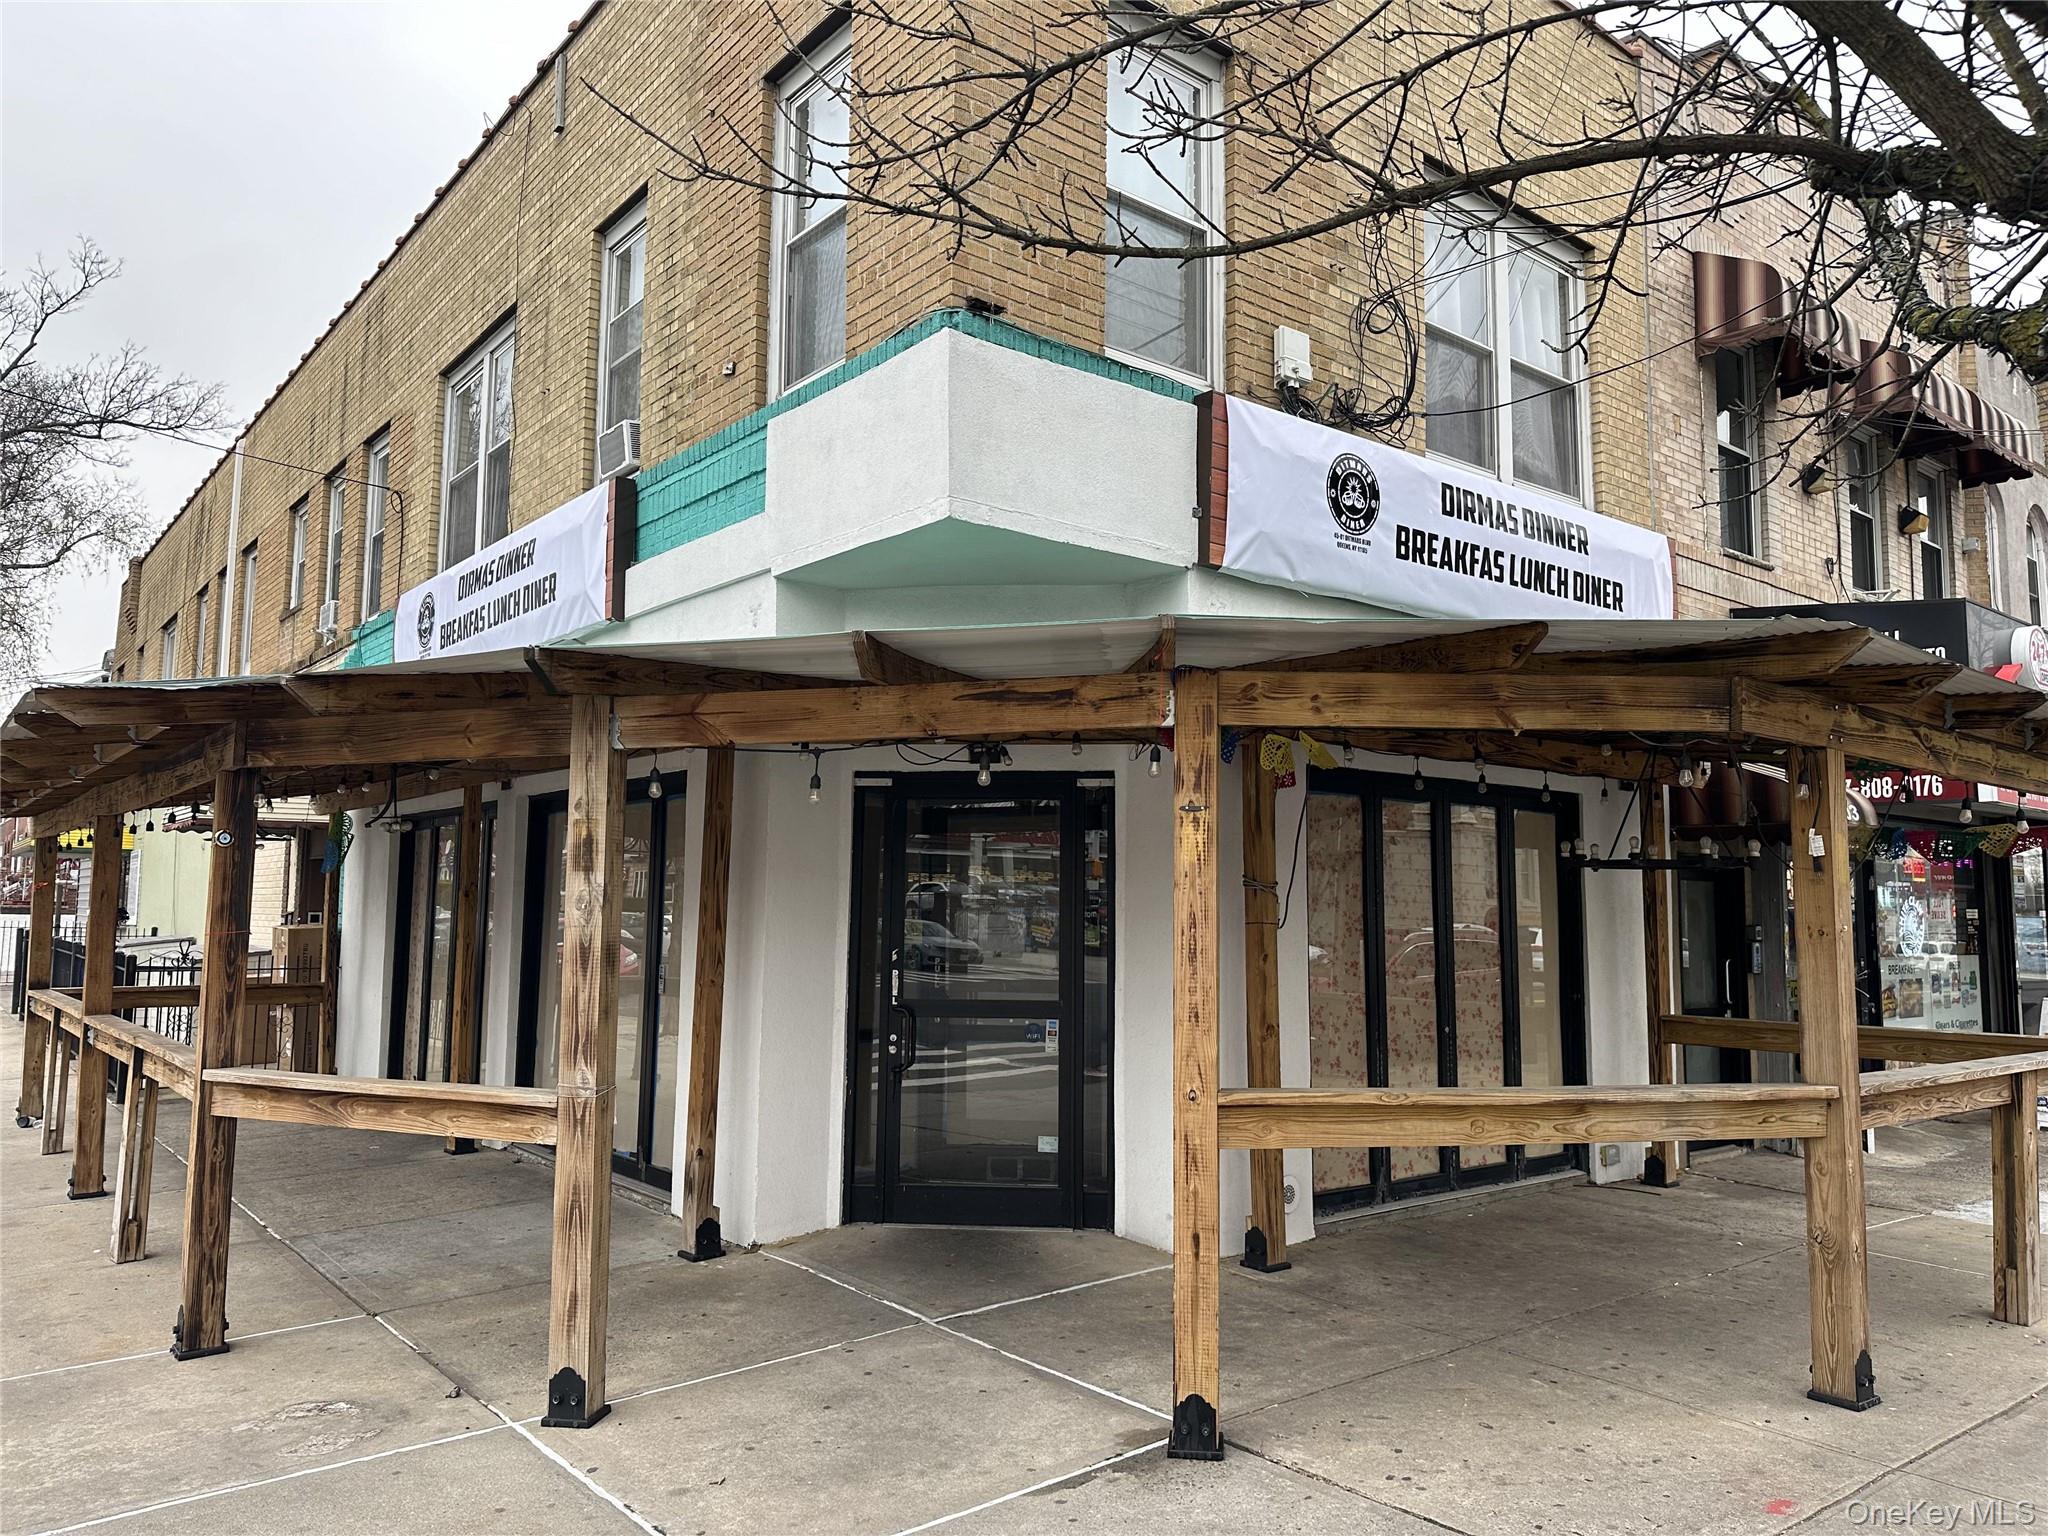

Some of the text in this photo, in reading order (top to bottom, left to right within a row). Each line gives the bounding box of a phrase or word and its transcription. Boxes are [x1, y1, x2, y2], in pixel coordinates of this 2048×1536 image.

[1335, 459, 1373, 484] DITMARS
[1340, 513, 1366, 530] DINER
[1441, 482, 1589, 555] DIRMAS DINNER
[458, 537, 537, 602] DIRMAS DINNER
[1396, 524, 1624, 613] BREAKFAS LUNCH DINER
[440, 604, 486, 650] BREAKFAS
[487, 588, 521, 630] LUNCH
[523, 572, 557, 615] DINER
[1888, 963, 1916, 976] BREAKFAST
